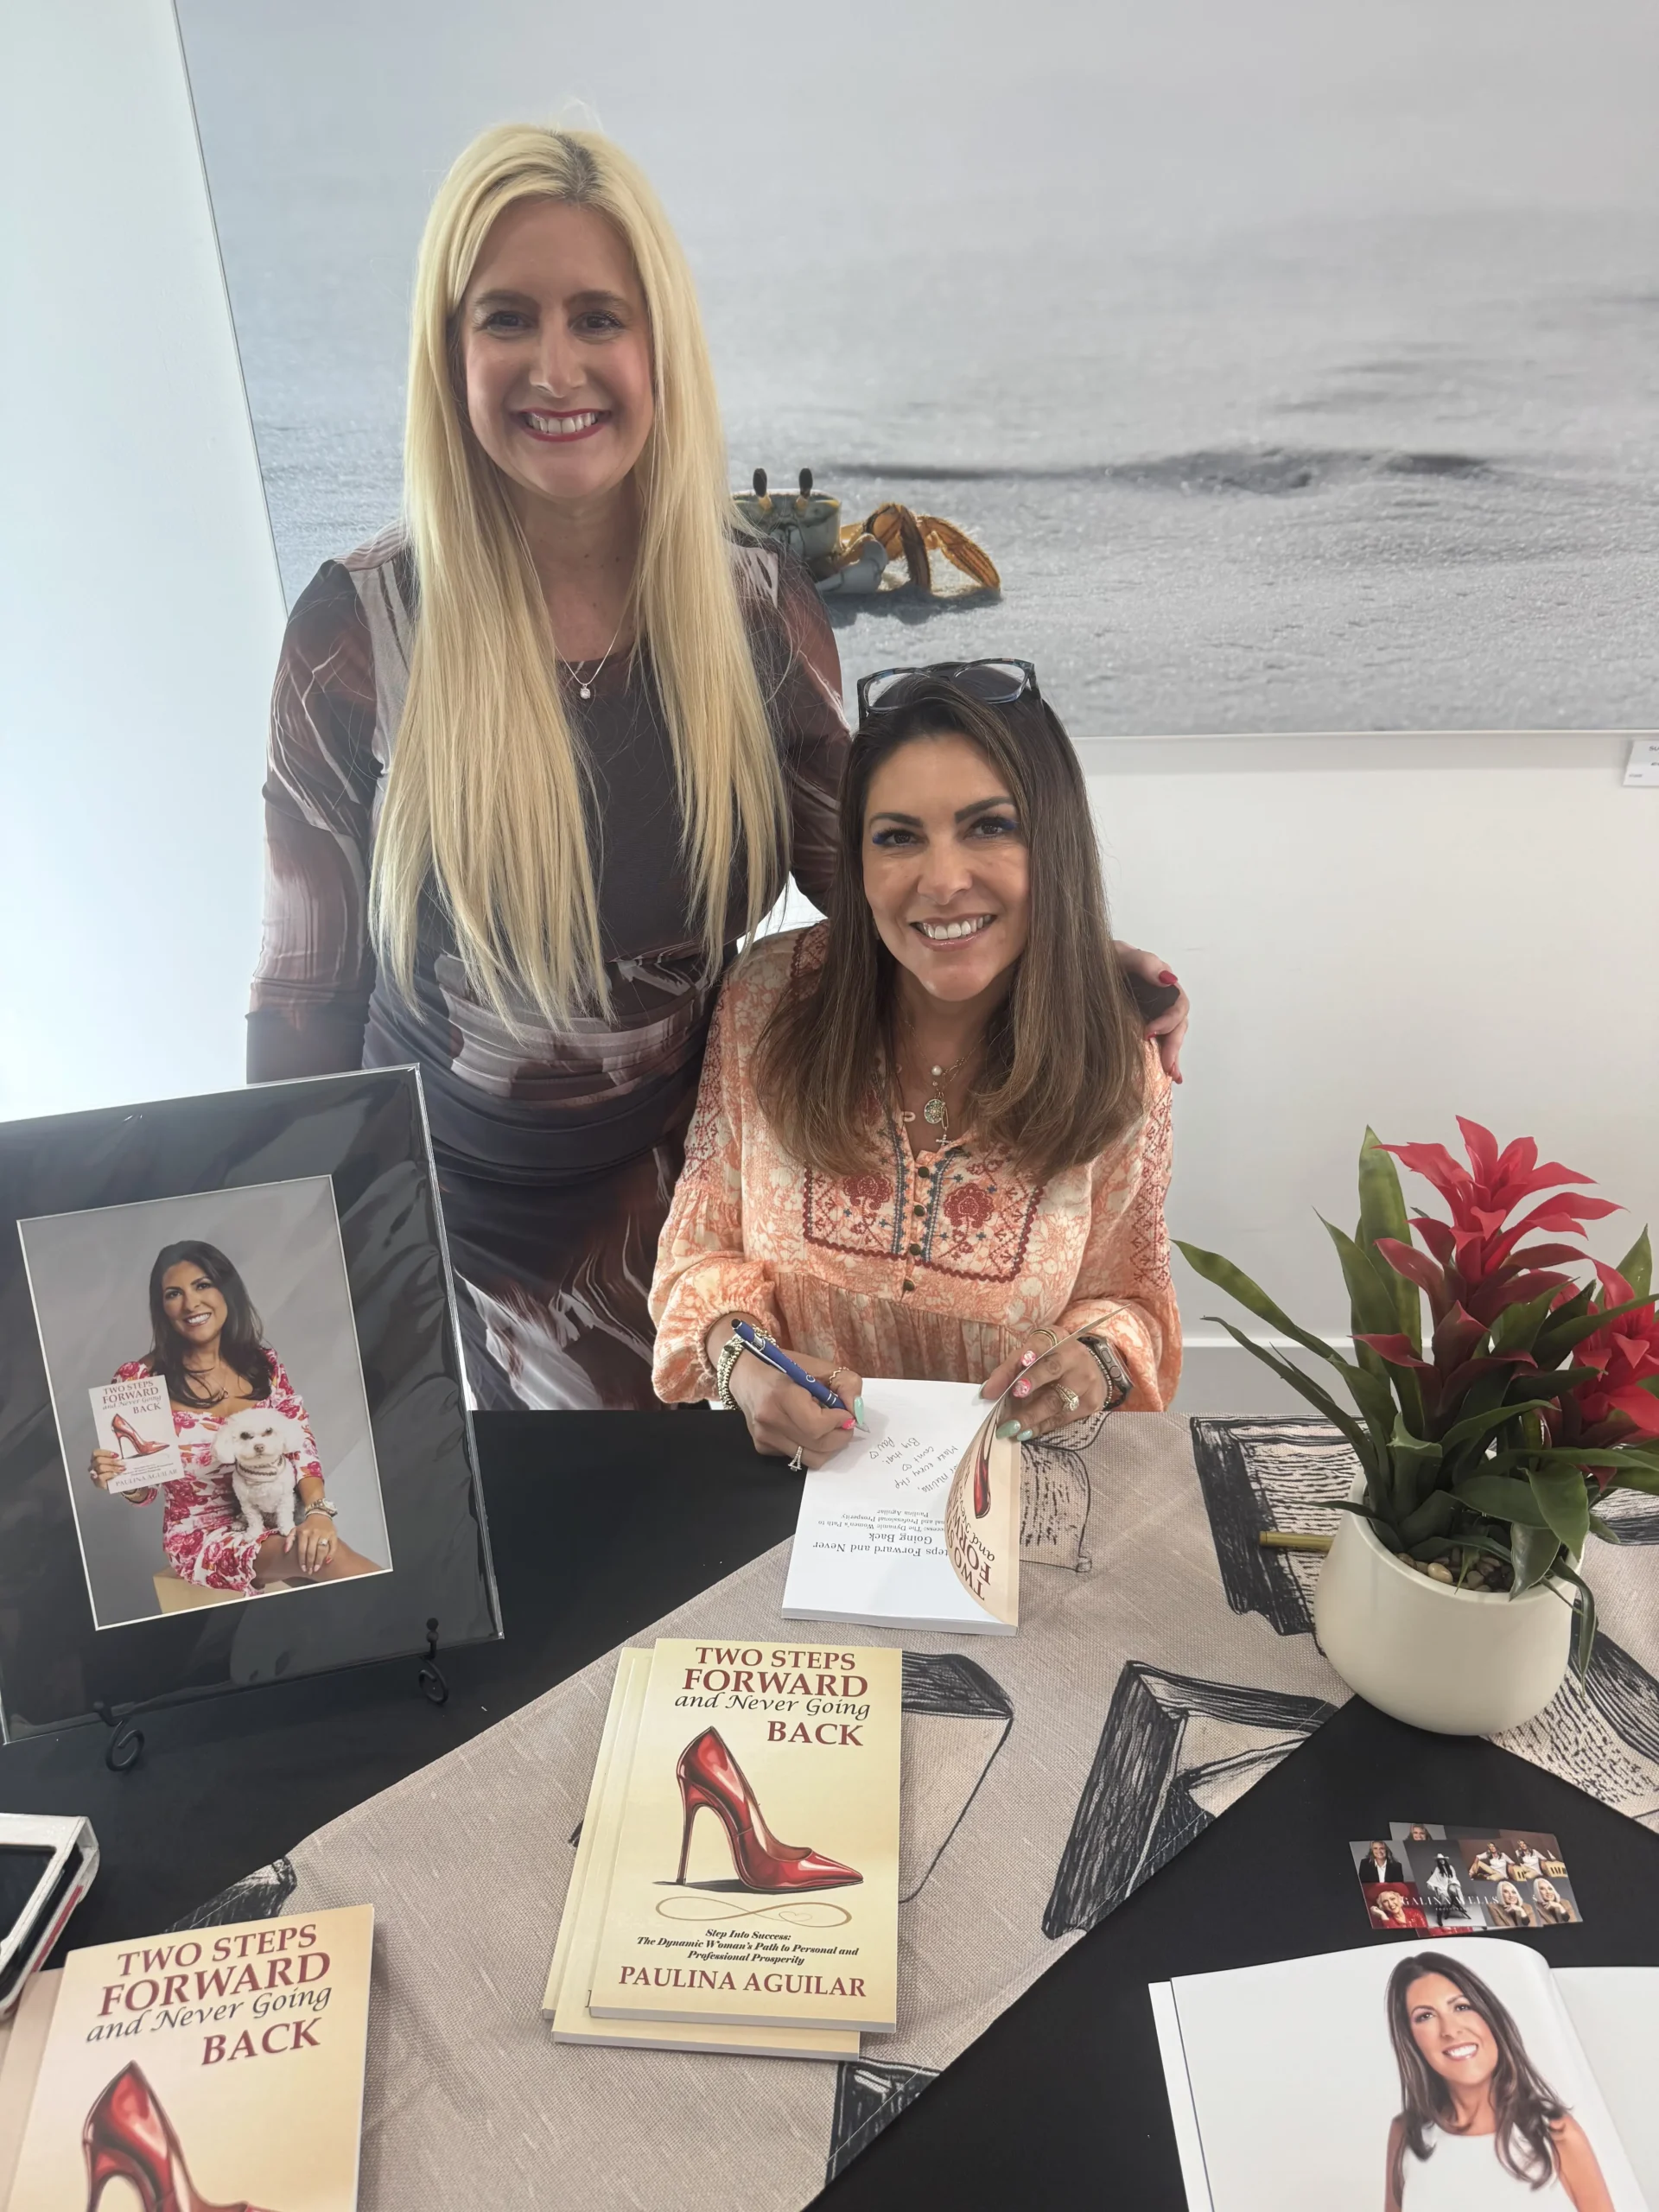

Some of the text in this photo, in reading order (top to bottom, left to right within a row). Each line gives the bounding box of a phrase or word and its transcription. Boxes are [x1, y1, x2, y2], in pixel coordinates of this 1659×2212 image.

[102, 1388, 159, 1403] FORWARD
[104, 1381, 154, 1395] TWO STEPS
[133, 1402, 161, 1414] BACK
[116, 1476, 145, 1486] PAULINA
[842, 1514, 875, 1522] Prosperity
[812, 1541, 845, 1552] Never
[868, 1533, 931, 1545] Going Back
[969, 1533, 995, 1561] and
[874, 1546, 921, 1557] Forward
[926, 1547, 949, 1556] teps
[954, 1547, 984, 1600] TWO
[696, 1647, 855, 1670] TWO STEPS
[682, 1668, 868, 1697] FORWARD
[675, 1692, 870, 1721] and Never Going
[767, 1720, 863, 1746] BACK
[705, 1929, 791, 1941] Step Into Success:
[118, 1924, 317, 1977] TWO STEPS
[637, 1936, 656, 1945] The
[657, 1937, 703, 1948] Dynamic
[705, 1940, 753, 1950] Woman's
[754, 1942, 779, 1951] Path
[791, 1944, 838, 1955] Personal
[687, 1950, 805, 1966] Professional Prosperity
[97, 1951, 331, 2017] FORWARD
[619, 1966, 867, 1997] PAULINA AGUILAR
[86, 1986, 332, 2043] and Never Going
[201, 2017, 322, 2066] BACK
